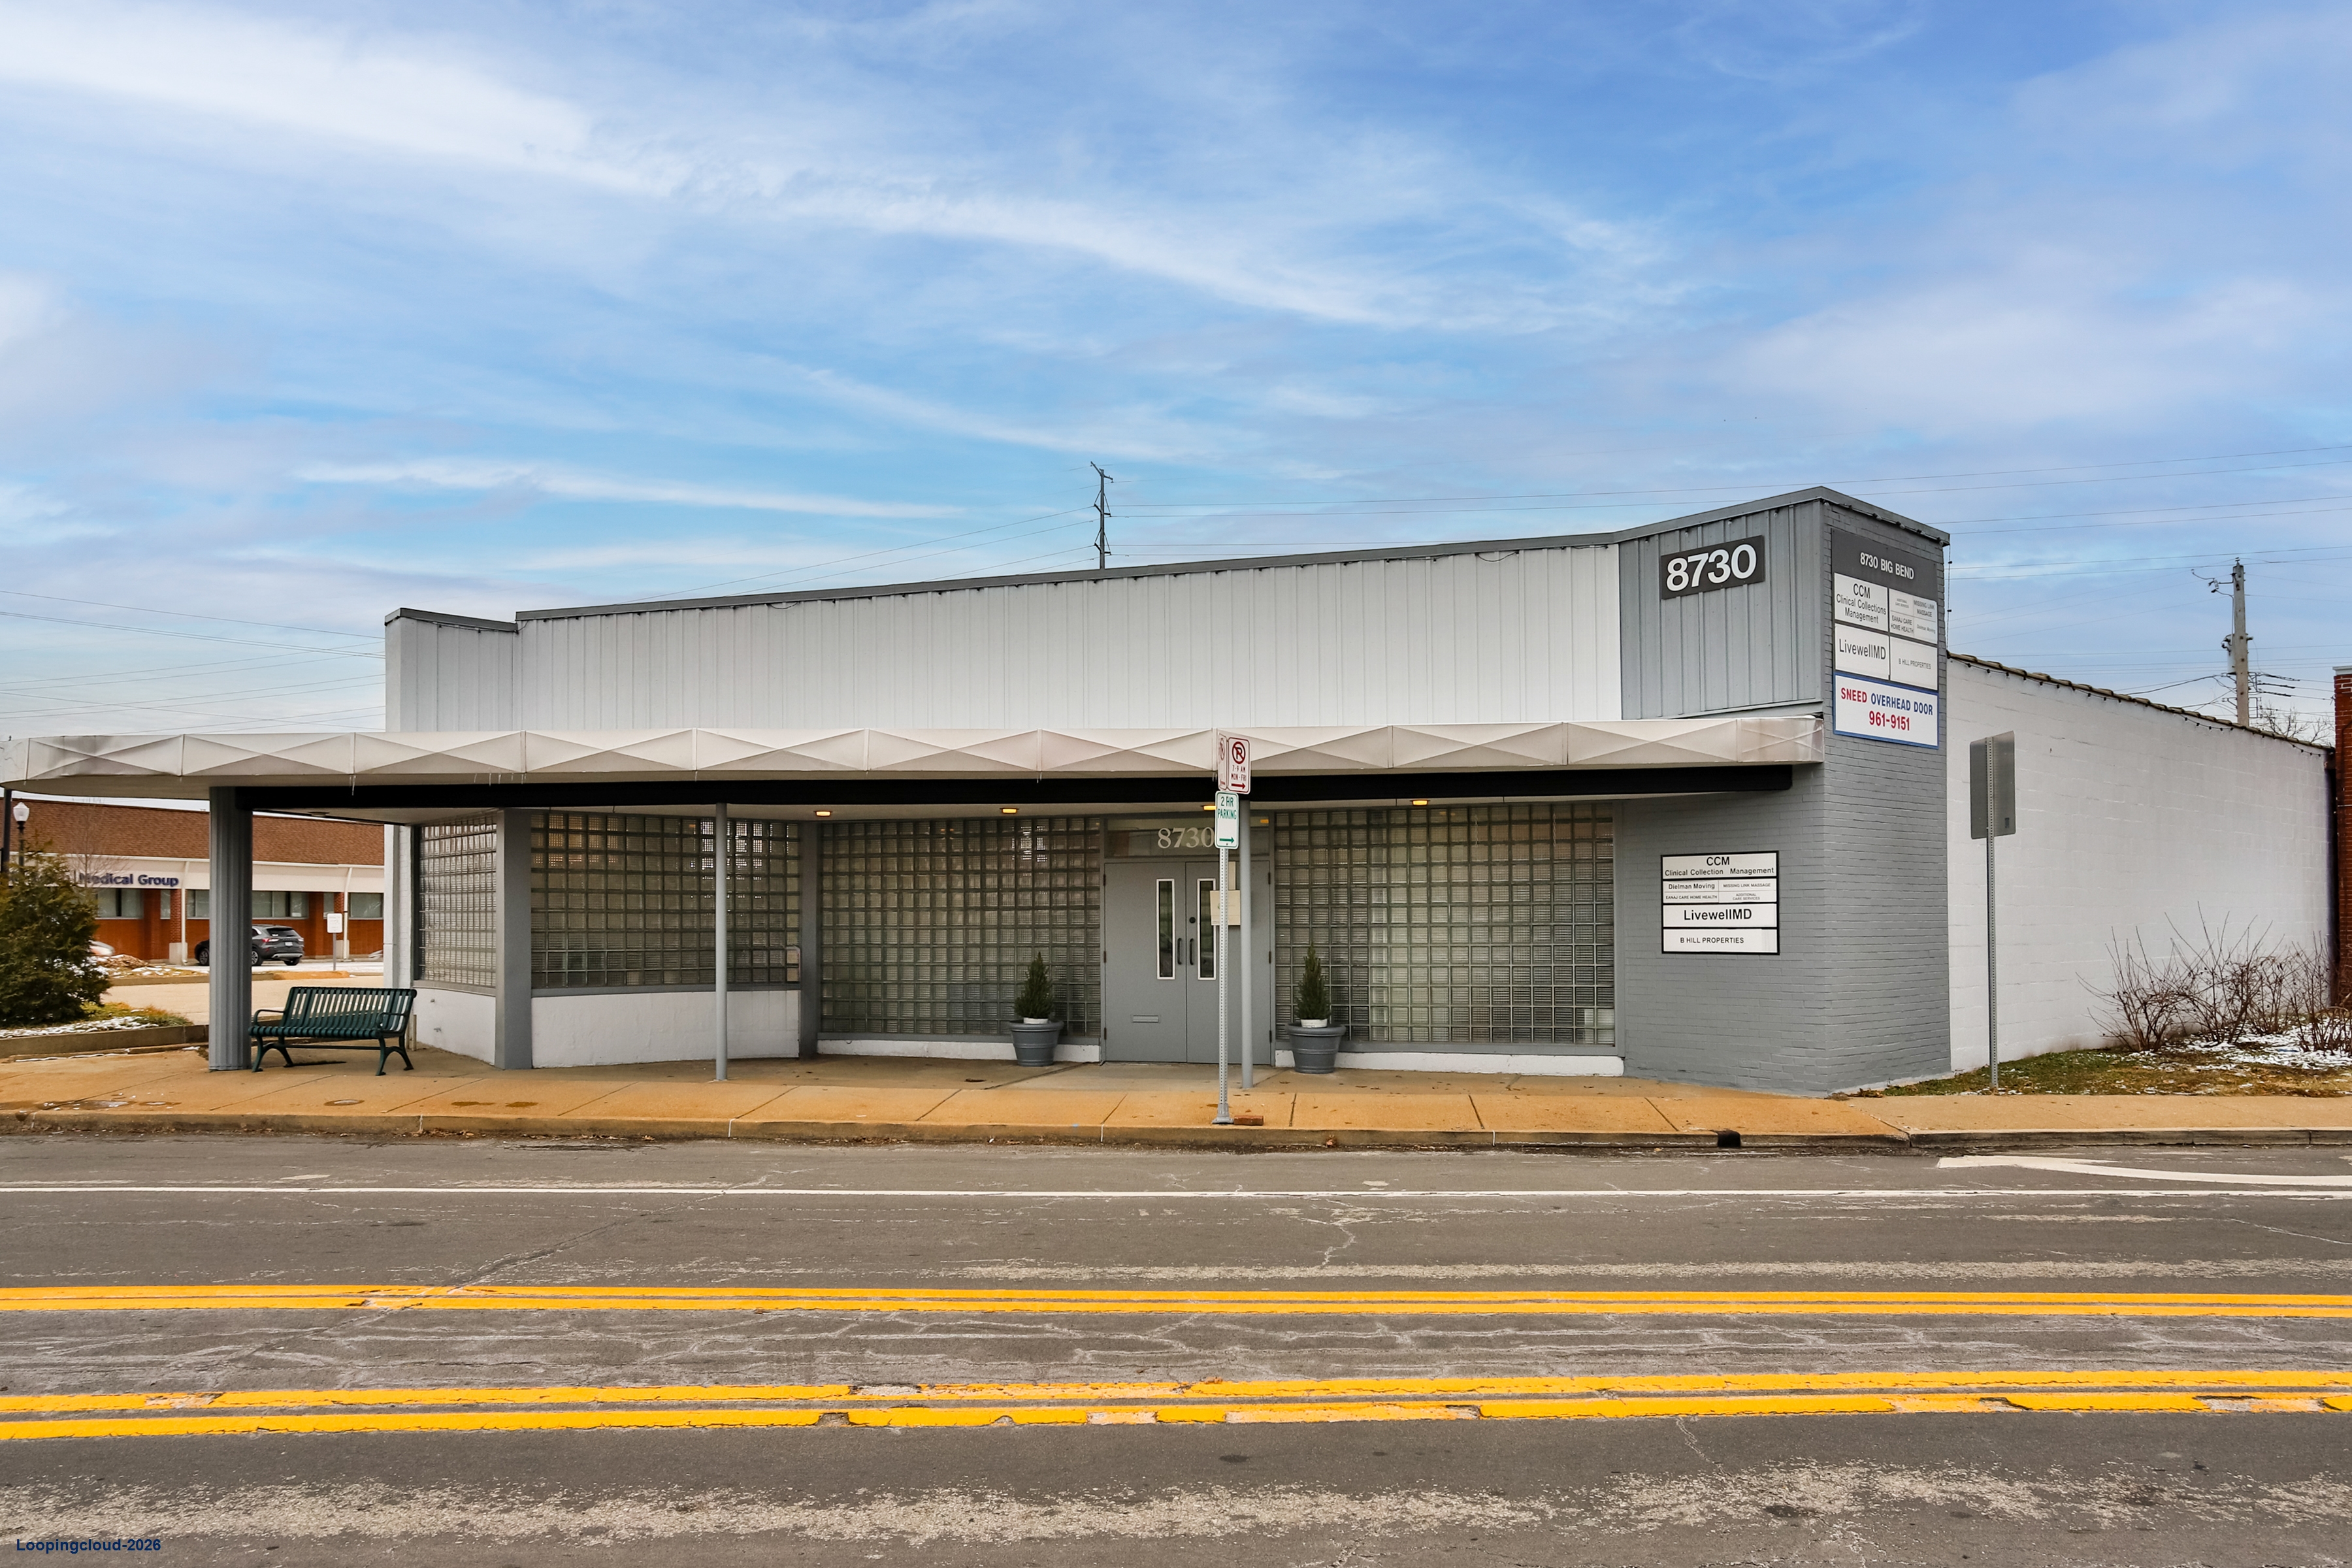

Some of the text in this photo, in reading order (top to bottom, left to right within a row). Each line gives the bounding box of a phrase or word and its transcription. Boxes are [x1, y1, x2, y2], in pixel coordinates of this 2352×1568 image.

[1667, 544, 1757, 591] 8730
[1860, 552, 1914, 580] 8730 BIG BEND
[1853, 583, 1870, 598] CCM
[1837, 594, 1855, 607] Clinical
[1857, 599, 1886, 615] Collections
[1845, 608, 1879, 624] Management
[1839, 639, 1886, 660] LivewellMD
[1910, 660, 1931, 669] PROPERTIES
[1841, 687, 1933, 715] SNEED OVERHEAD DOOR
[1869, 711, 1910, 731] 961-9151
[1220, 796, 1233, 807] 2 HR
[1218, 809, 1237, 819] PARKING
[1158, 827, 1215, 849] 8730
[1707, 857, 1730, 866] CCM
[80, 873, 133, 885] Medical
[138, 874, 179, 887] Group
[1684, 909, 1752, 921] LivewellMD
